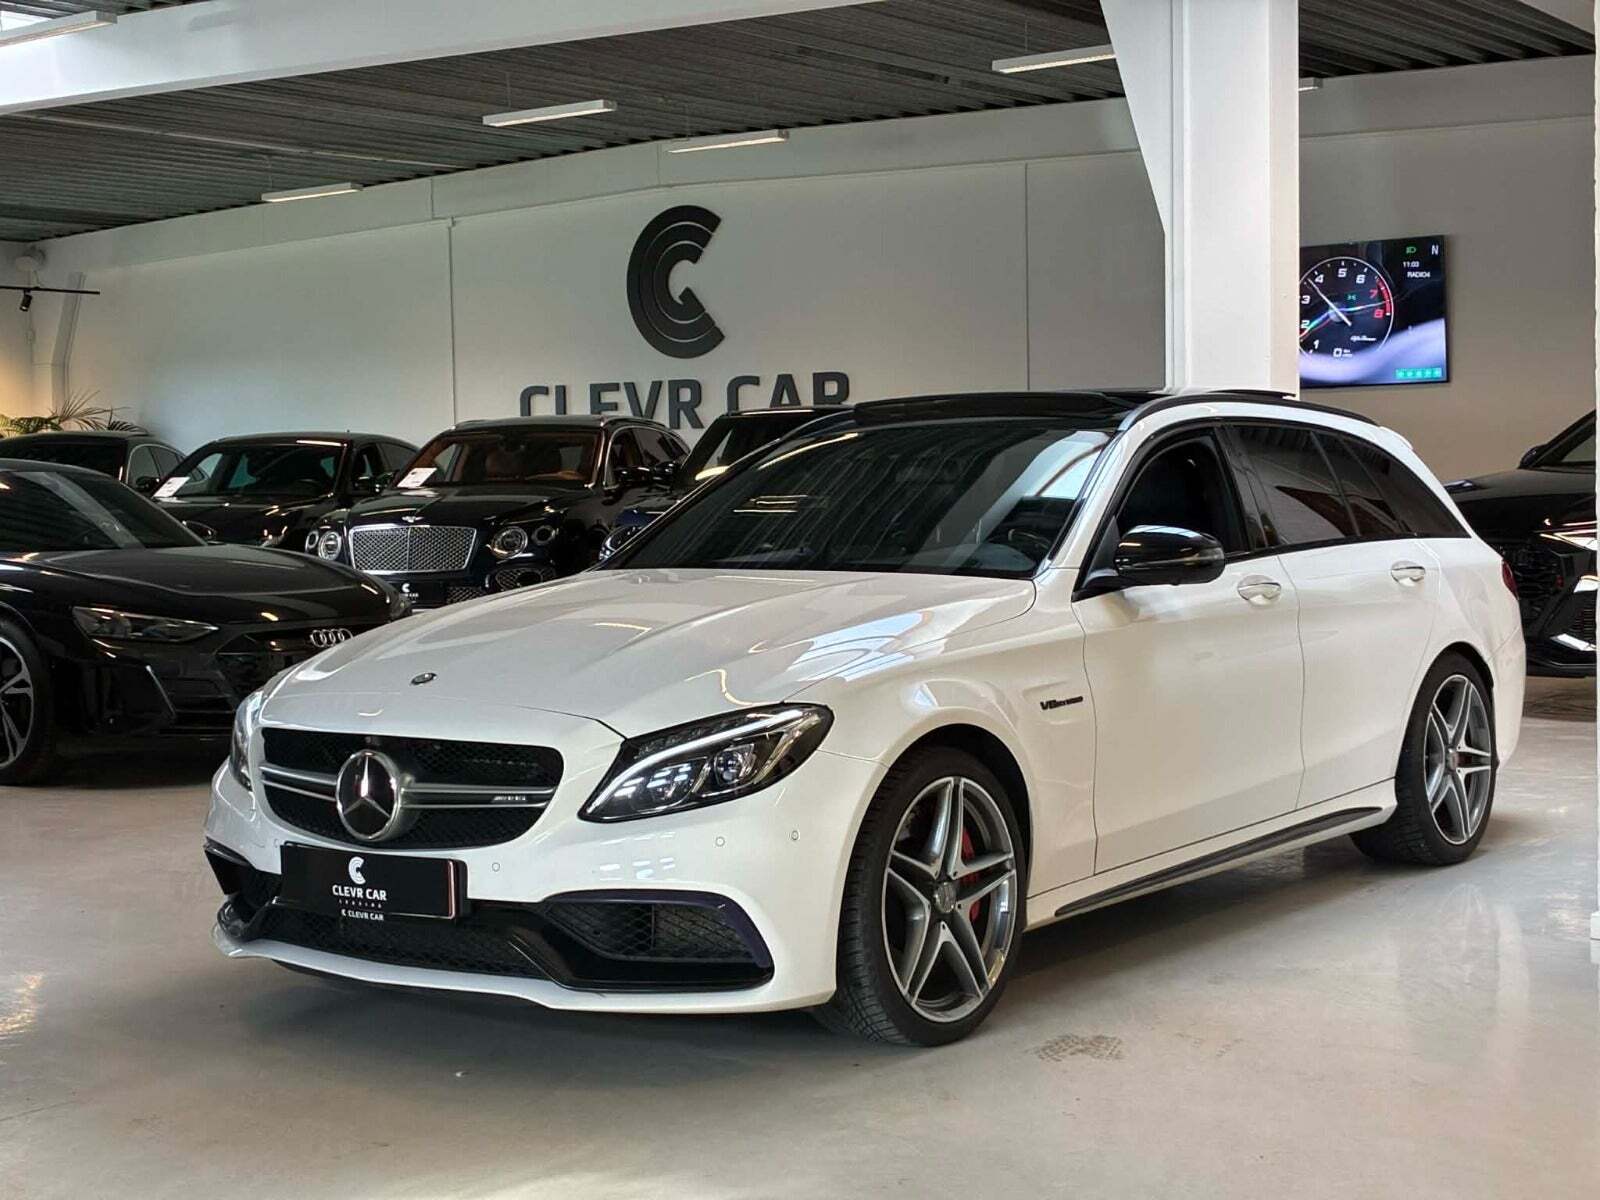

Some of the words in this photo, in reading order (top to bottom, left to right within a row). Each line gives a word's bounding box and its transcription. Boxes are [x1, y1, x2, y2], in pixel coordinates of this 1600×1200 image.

[1431, 244, 1439, 255] N
[1337, 268, 1347, 277] 5
[1314, 274, 1324, 283] 4
[1356, 274, 1365, 283] 6
[1369, 289, 1378, 299] 7
[1301, 295, 1310, 304] 3
[1301, 319, 1310, 328] 2
[1313, 339, 1320, 349] 1
[726, 371, 850, 412] CAR
[332, 884, 363, 898] CLEVR
[365, 888, 386, 900] CAR
[348, 910, 368, 919] CLEVR
[369, 912, 384, 920] CAR
